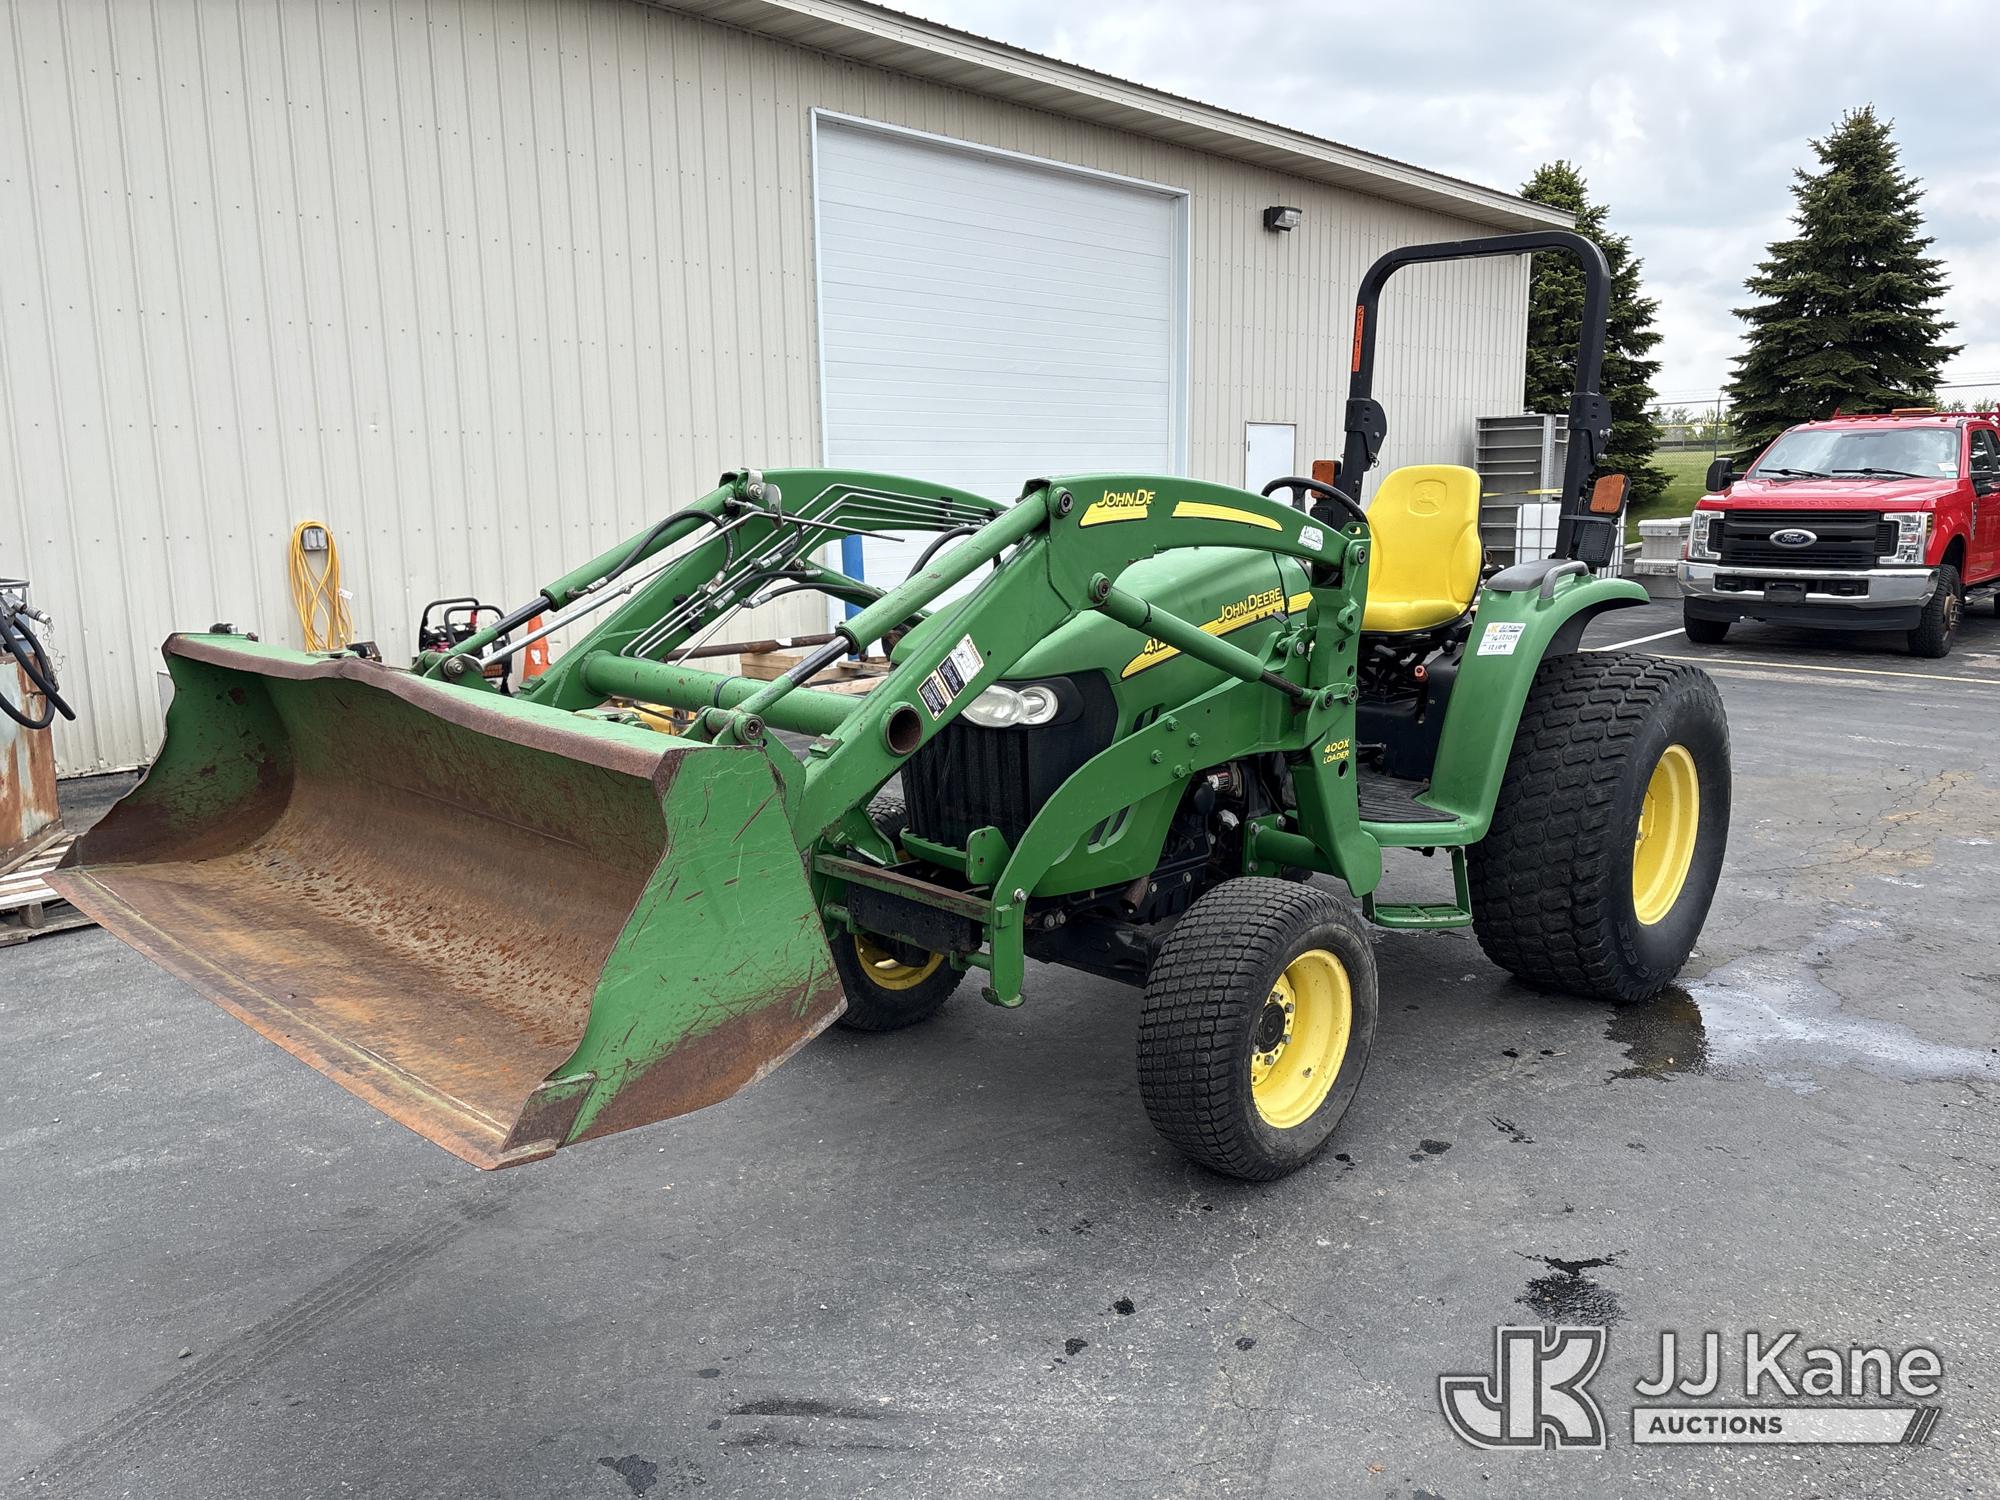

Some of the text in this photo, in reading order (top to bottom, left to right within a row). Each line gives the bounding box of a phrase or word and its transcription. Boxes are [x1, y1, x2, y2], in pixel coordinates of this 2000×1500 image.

[1097, 490, 1135, 507] JOHN
[1781, 533, 1804, 543] Ford
[1218, 587, 1281, 623] JOHN DEERE
[1323, 738, 1350, 754] 400X
[1323, 750, 1350, 765] LOADER
